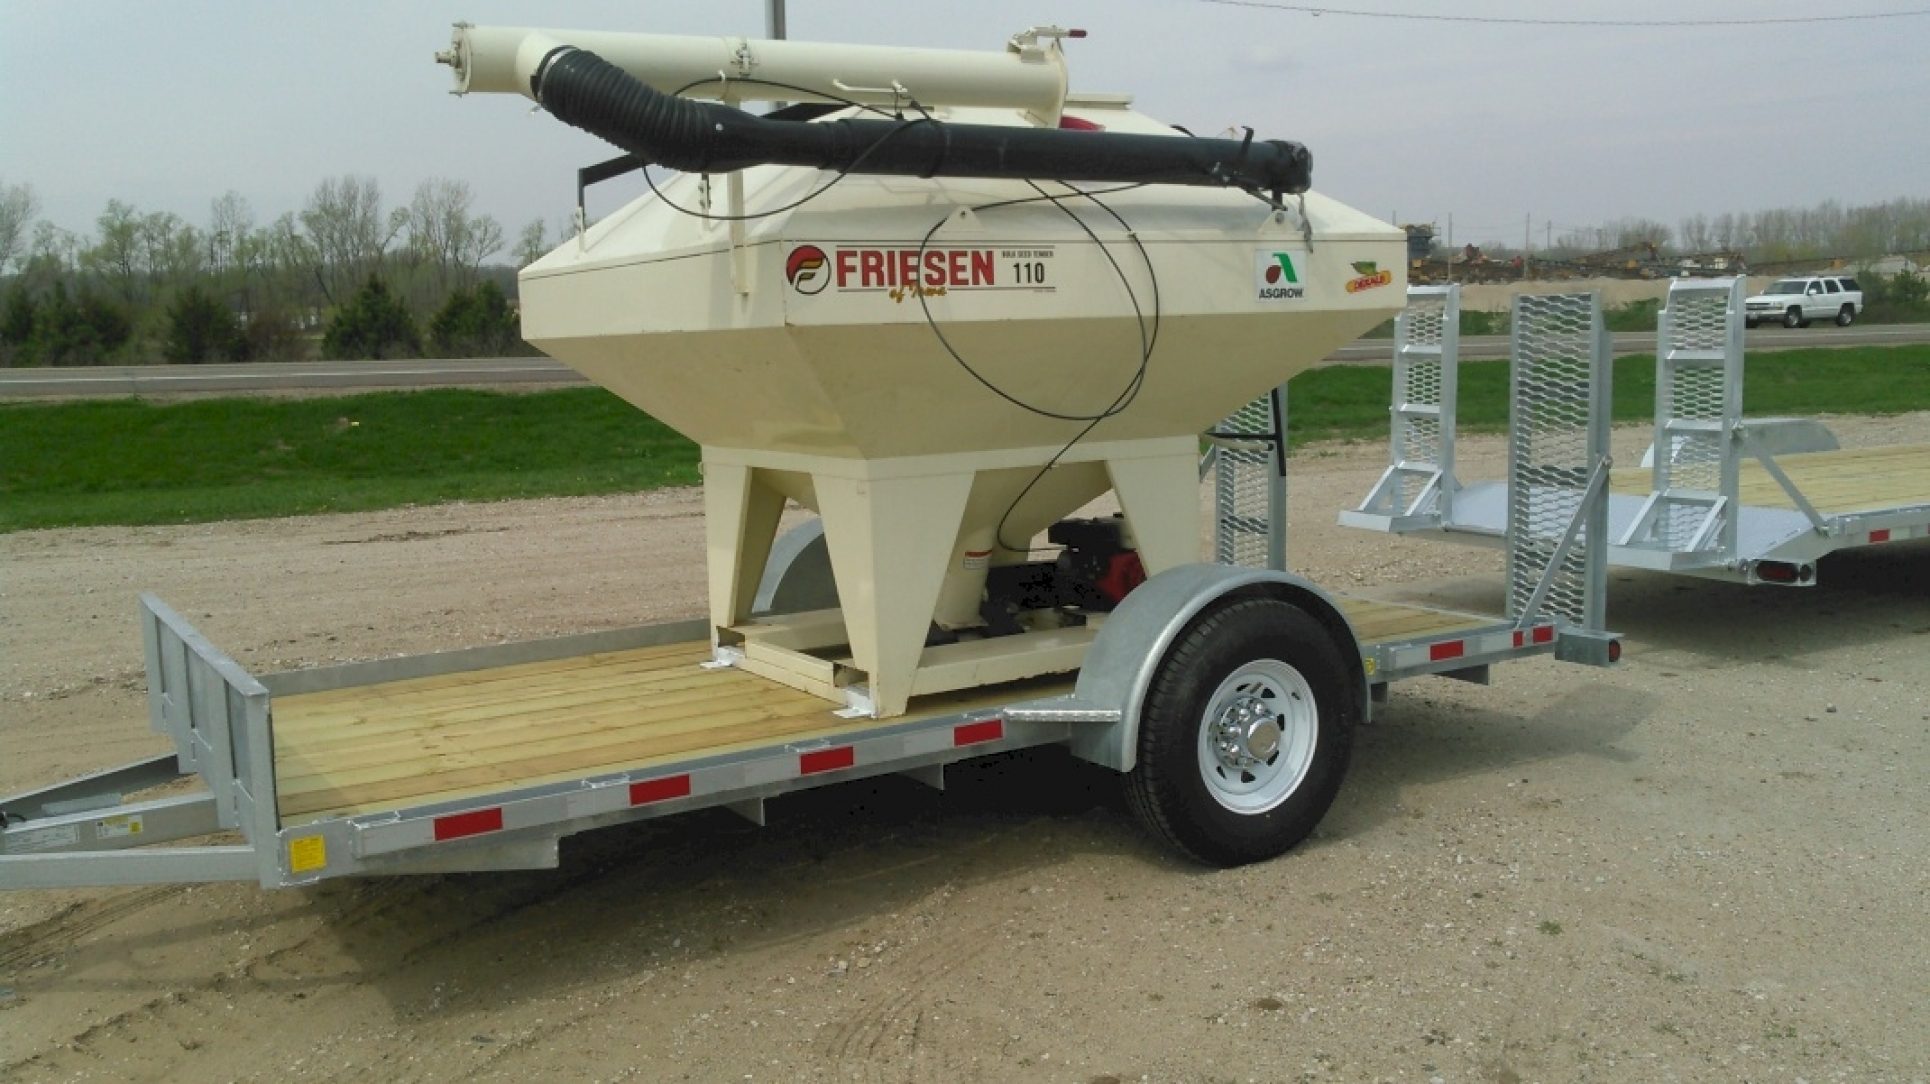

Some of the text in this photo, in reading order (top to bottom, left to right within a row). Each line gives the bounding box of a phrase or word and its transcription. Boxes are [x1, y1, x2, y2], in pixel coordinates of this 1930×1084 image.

[836, 250, 995, 287] FRIESEN
[1012, 262, 1045, 284] 110
[1259, 288, 1304, 299] ASGROW
